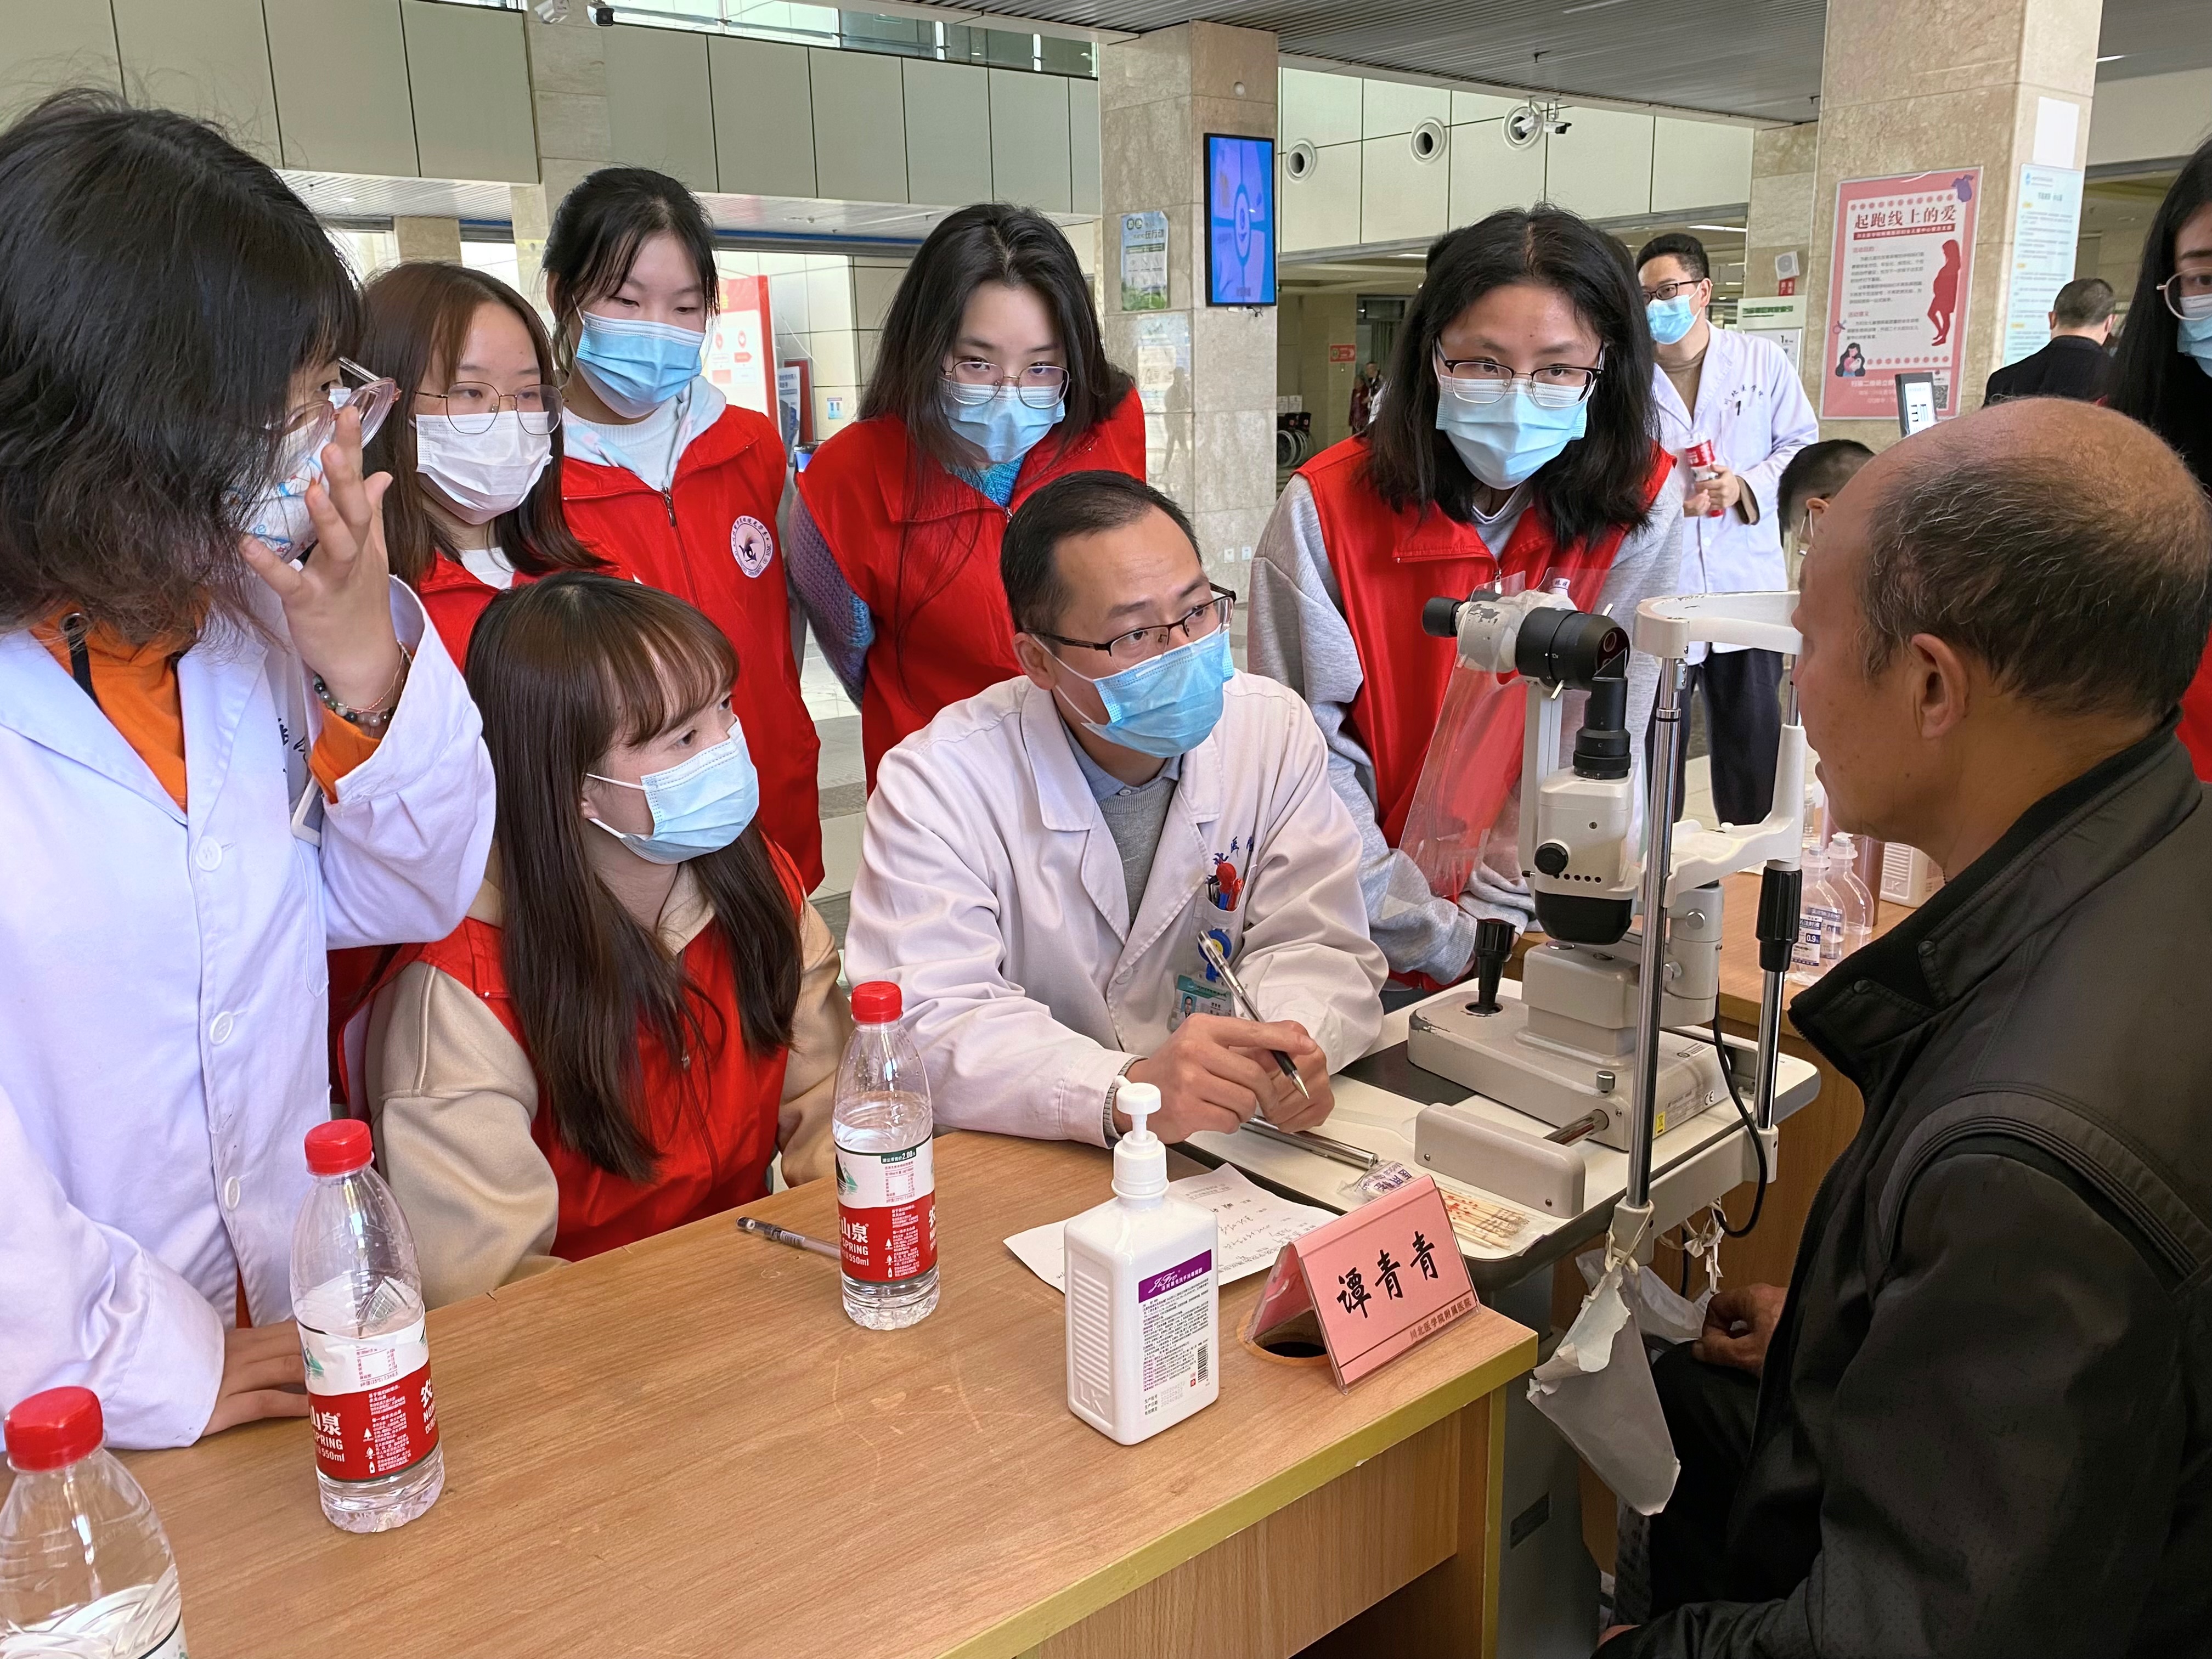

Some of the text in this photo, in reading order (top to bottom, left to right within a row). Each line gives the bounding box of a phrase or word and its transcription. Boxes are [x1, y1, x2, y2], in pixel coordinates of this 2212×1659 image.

[1854, 205, 1956, 229] 起跑线上的爱
[1704, 1091, 1713, 1105] CE
[839, 1216, 868, 1244] 山泉
[842, 1237, 869, 1256] SPRING
[849, 1253, 870, 1267] 550ml
[1336, 1231, 1438, 1319] 谭青青
[1410, 1297, 1471, 1341] 川北医学院附属医院
[309, 1405, 342, 1436] 山泉
[313, 1429, 343, 1451] SPRING
[321, 1447, 345, 1463] 550ml
